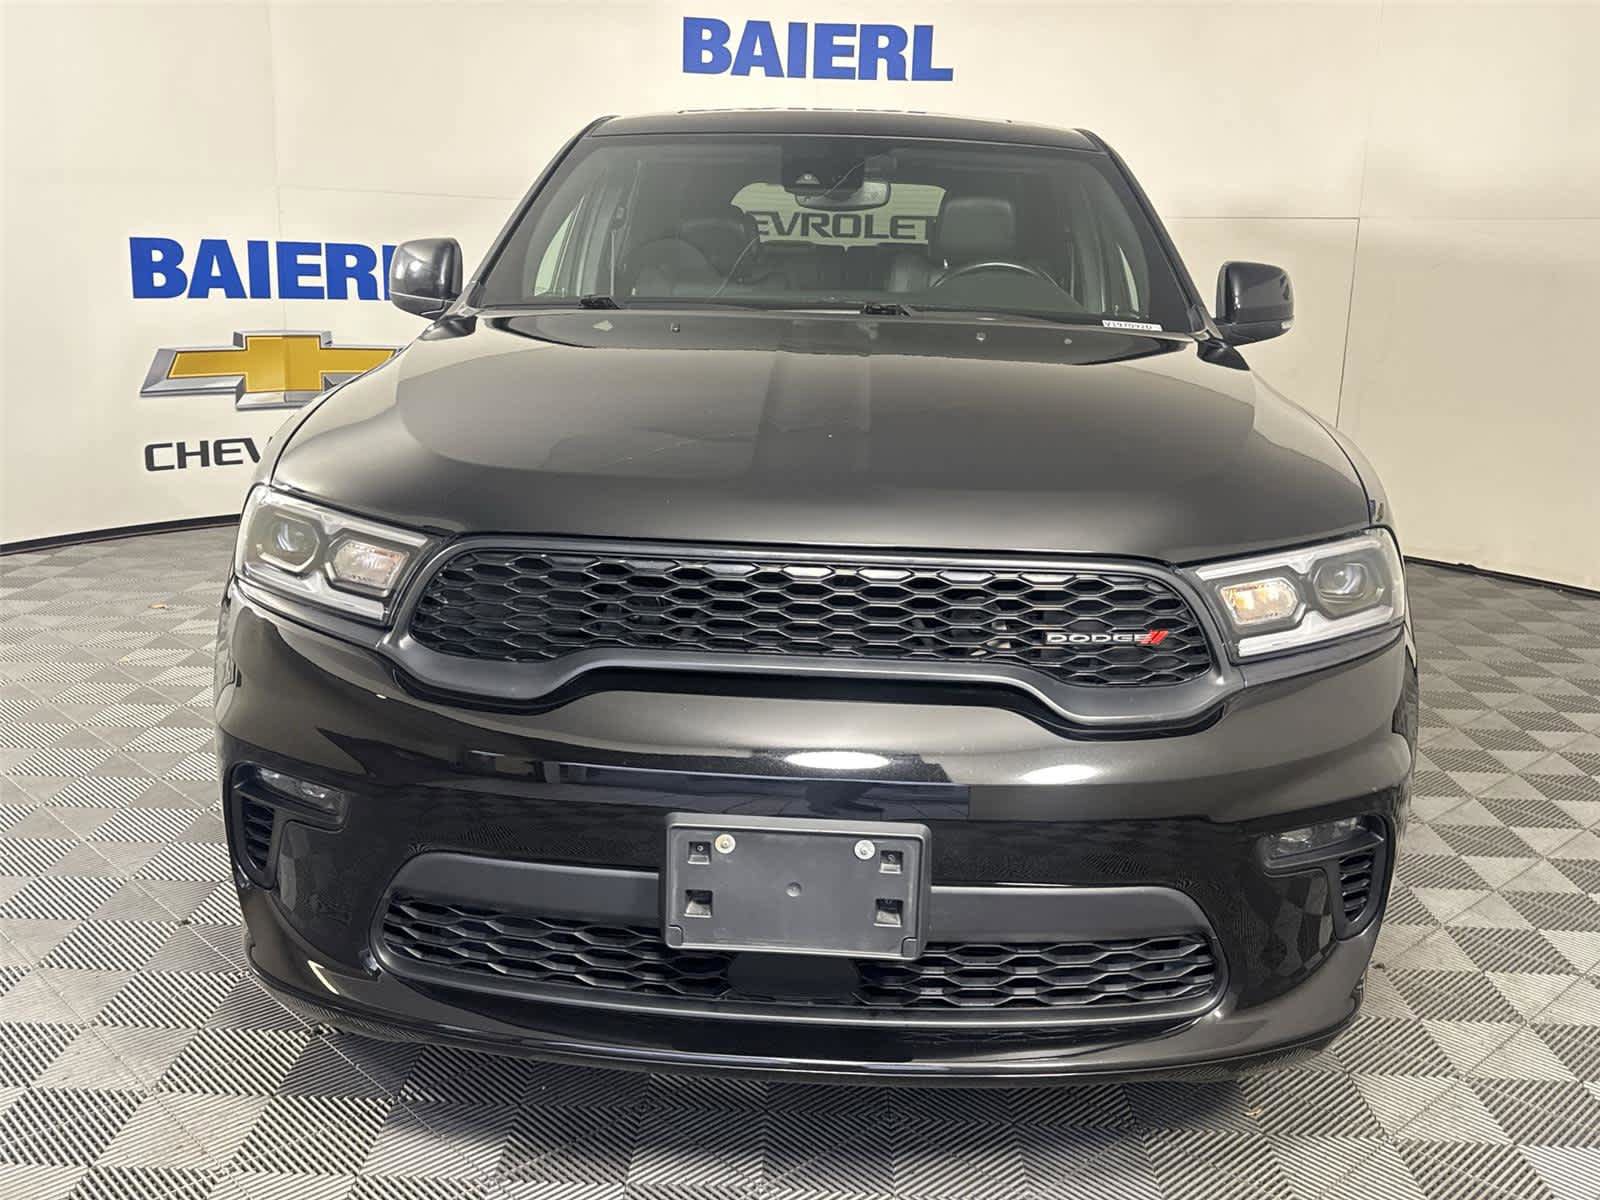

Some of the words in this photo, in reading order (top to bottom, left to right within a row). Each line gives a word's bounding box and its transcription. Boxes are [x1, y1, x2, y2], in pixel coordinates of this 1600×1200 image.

[682, 16, 954, 81] BAIERL
[129, 237, 396, 301] BAIER
[1046, 633, 1151, 644] DODGE
